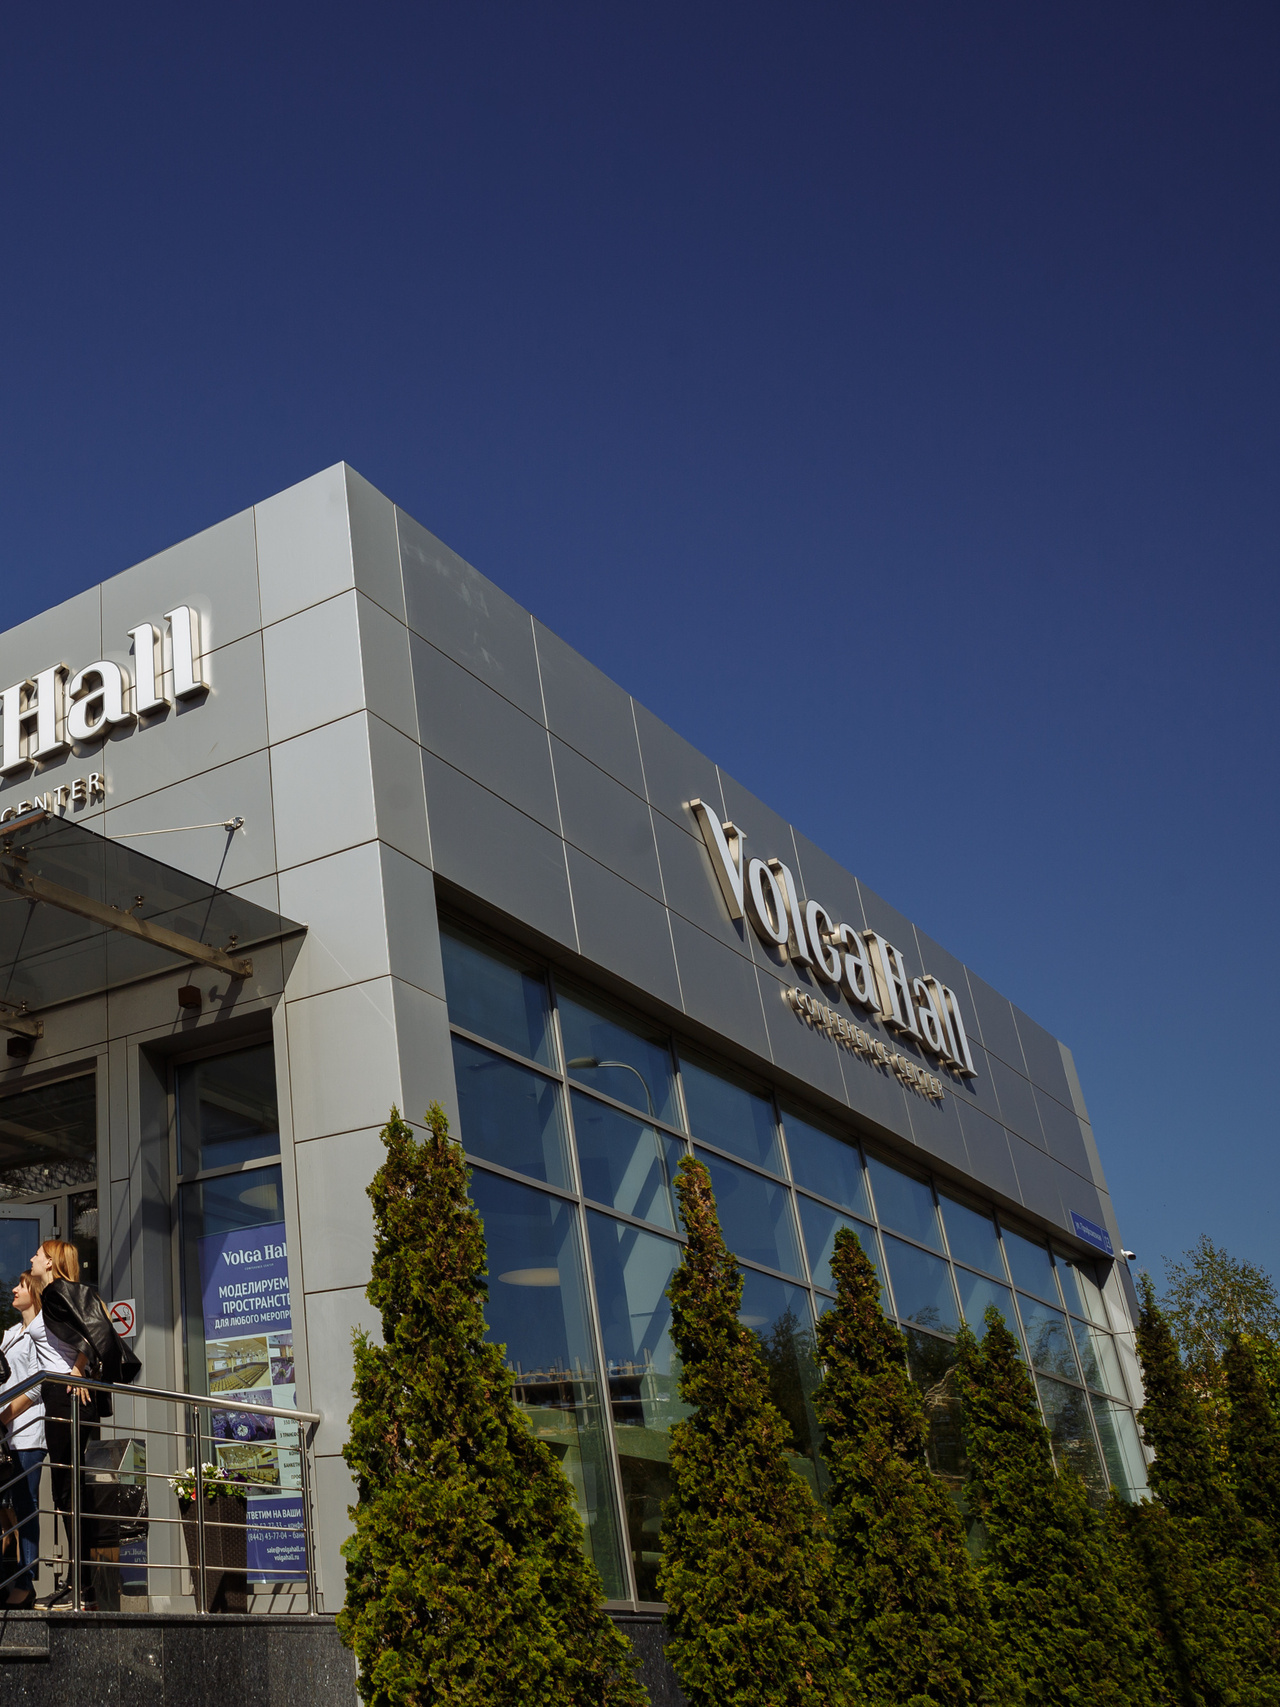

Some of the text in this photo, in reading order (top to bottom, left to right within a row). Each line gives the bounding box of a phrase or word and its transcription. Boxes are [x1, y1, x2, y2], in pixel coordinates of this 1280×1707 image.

[1, 772, 106, 824] CENTER
[863, 929, 978, 1079] Hall
[788, 986, 945, 1100] CONFERENCE CENTER
[218, 1276, 289, 1299] МОДЕЛИРУЕМ
[214, 1309, 292, 1330] ДЛЯ ЛЮБОГО МЕРОПР
[272, 1509, 282, 1518] НА
[282, 1508, 301, 1518] ВАШИ
